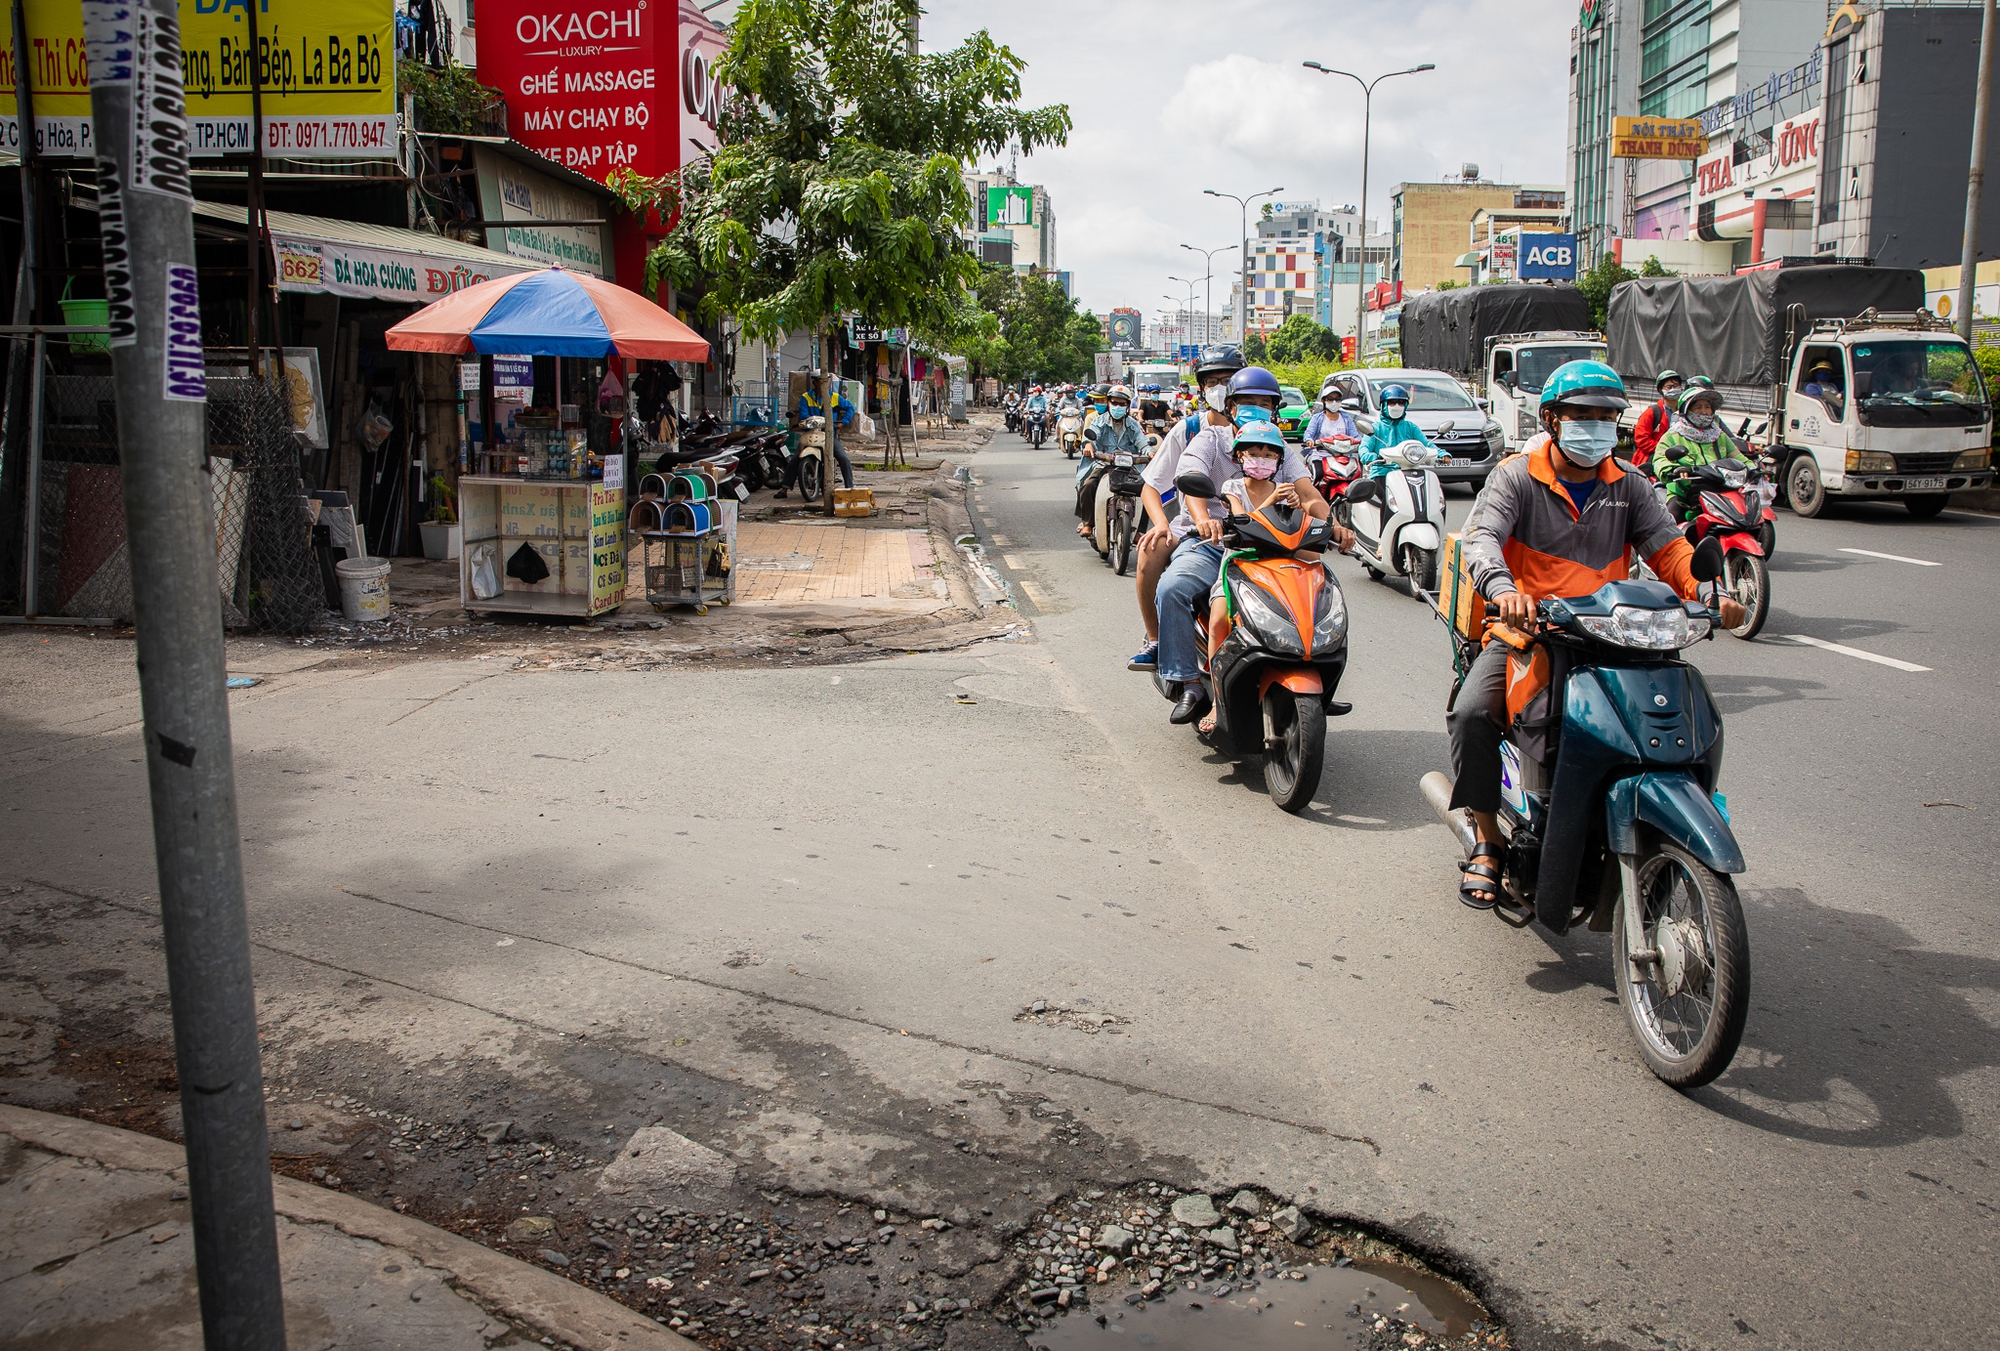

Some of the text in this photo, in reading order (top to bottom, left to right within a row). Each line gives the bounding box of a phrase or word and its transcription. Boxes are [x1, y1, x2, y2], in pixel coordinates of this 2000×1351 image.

[516, 9, 641, 43] OKACHI
[33, 38, 61, 86] Thi
[220, 36, 252, 86] Bàn
[258, 25, 297, 98] Bếp,
[303, 36, 323, 85] La
[329, 35, 352, 85] Ba
[357, 34, 381, 85] Bò
[559, 45, 603, 57] LUXURY
[520, 65, 655, 95] GHẾ MASSAGE
[525, 101, 649, 131] MÁY CHẠY BỘ
[47, 121, 77, 151] Hòa,
[195, 122, 249, 148] TP.HCM
[269, 122, 291, 148] ĐT:
[296, 121, 386, 148] 0971.770.947
[1632, 120, 1695, 138] NỘI THẤT
[566, 146, 602, 169] ĐẠP
[605, 140, 638, 167] TẬP
[1619, 138, 1702, 156] THANH DŨNG
[979, 182, 987, 232] HOTEL
[1495, 235, 1513, 244] 461
[1526, 246, 1572, 266] ACB
[283, 258, 319, 279] 662
[334, 253, 351, 284] ĐÁ
[353, 261, 378, 287] HOA
[1159, 326, 1186, 334] KEWPIE
[609, 549, 620, 563] Đá
[594, 588, 625, 611] Card ĐT
